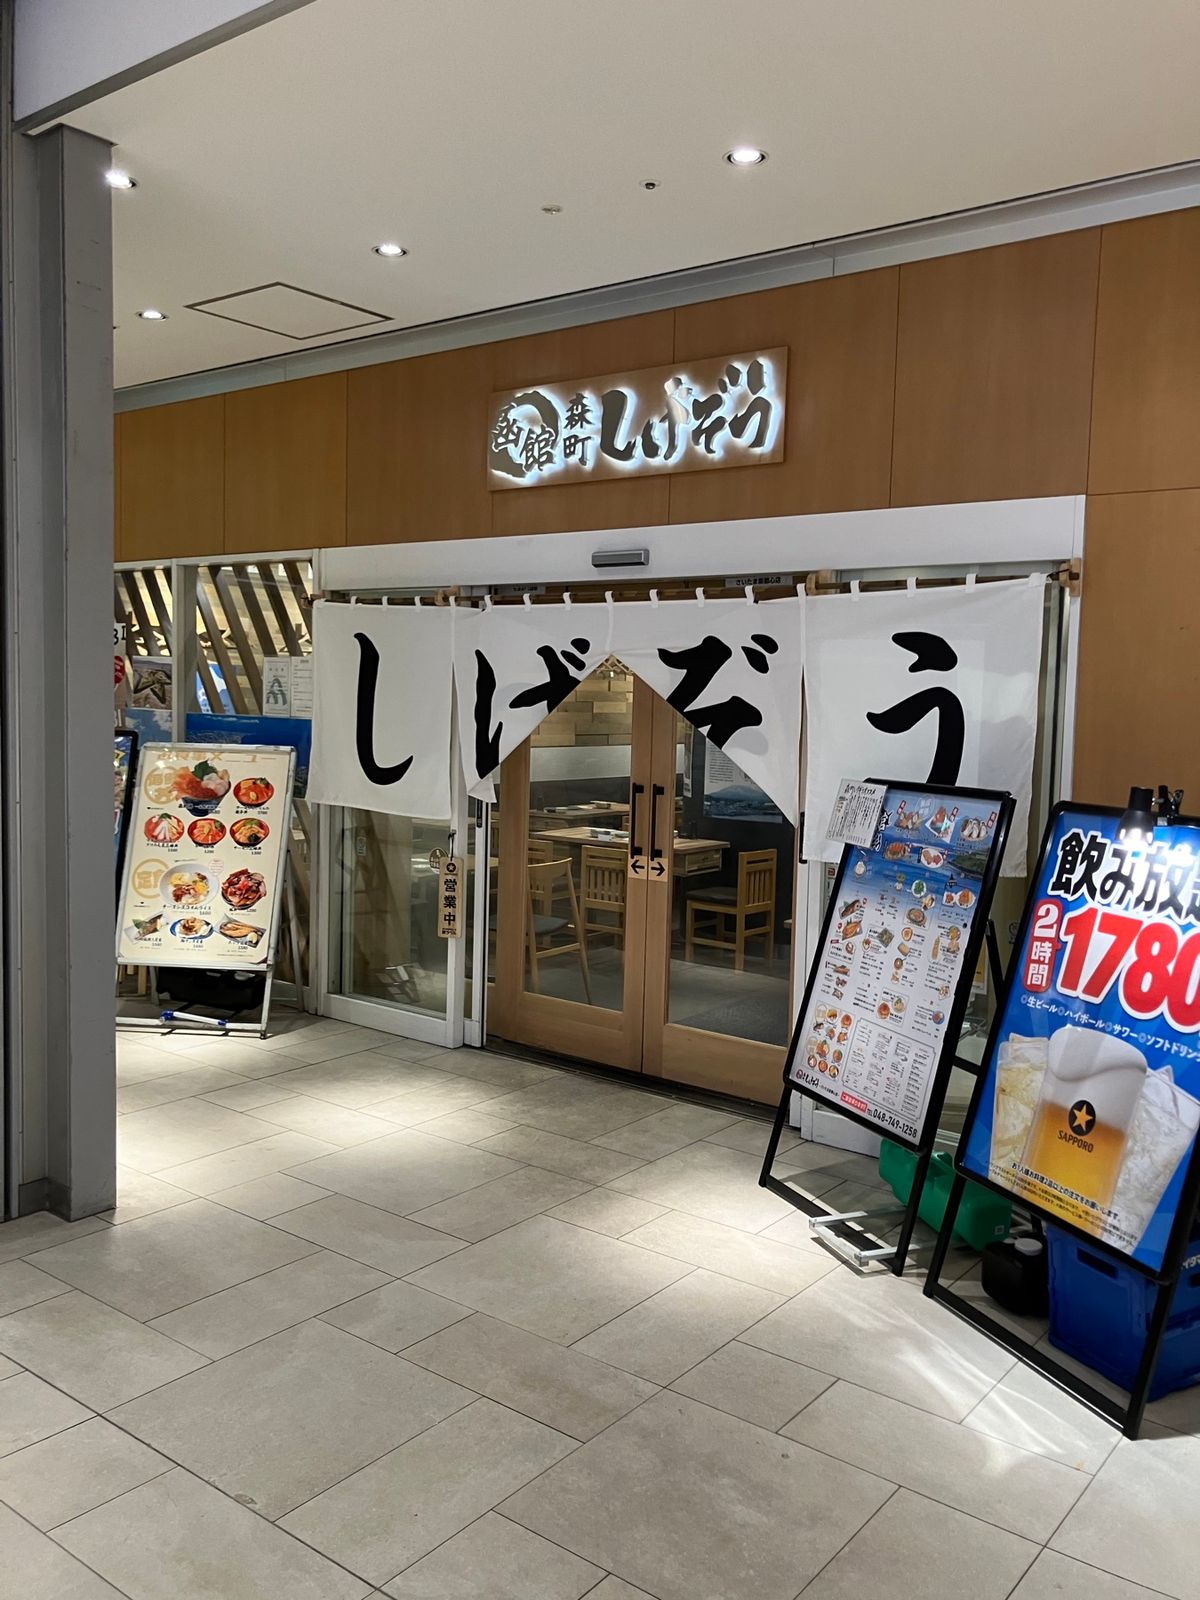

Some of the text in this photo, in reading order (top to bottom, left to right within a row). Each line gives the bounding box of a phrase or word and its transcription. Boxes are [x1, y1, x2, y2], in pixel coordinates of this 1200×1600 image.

[563, 392, 594, 467] 森町
[600, 359, 772, 462] しげぞう
[353, 627, 966, 786] しげぞう
[443, 878, 458, 926] 営業中
[1026, 904, 1059, 987] 2時間
[1026, 996, 1058, 1013] 生ビール
[1064, 1010, 1106, 1028] ハイボール
[1112, 1024, 1139, 1040] サワー
[873, 1108, 918, 1138] 048-749-1258
[1057, 1132, 1094, 1153] SAPPORO
